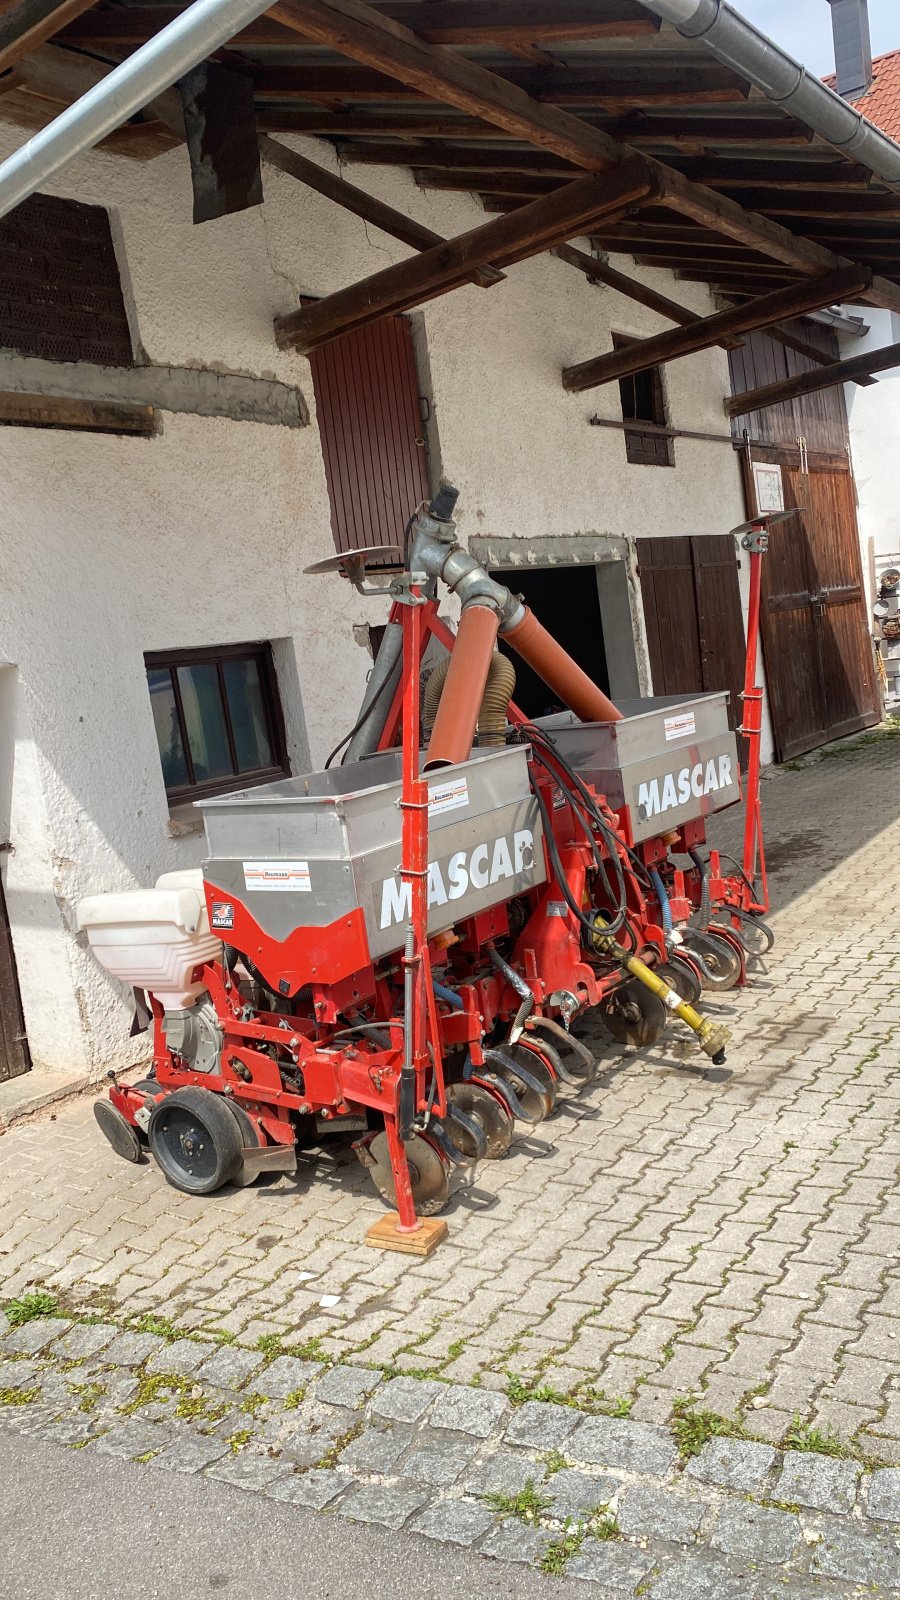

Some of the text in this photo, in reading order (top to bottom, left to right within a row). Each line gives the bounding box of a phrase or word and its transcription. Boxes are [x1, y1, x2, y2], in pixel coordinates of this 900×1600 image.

[638, 754, 733, 818] MASCAR
[380, 829, 534, 930] MASCAR
[212, 918, 233, 926] MASCAR
